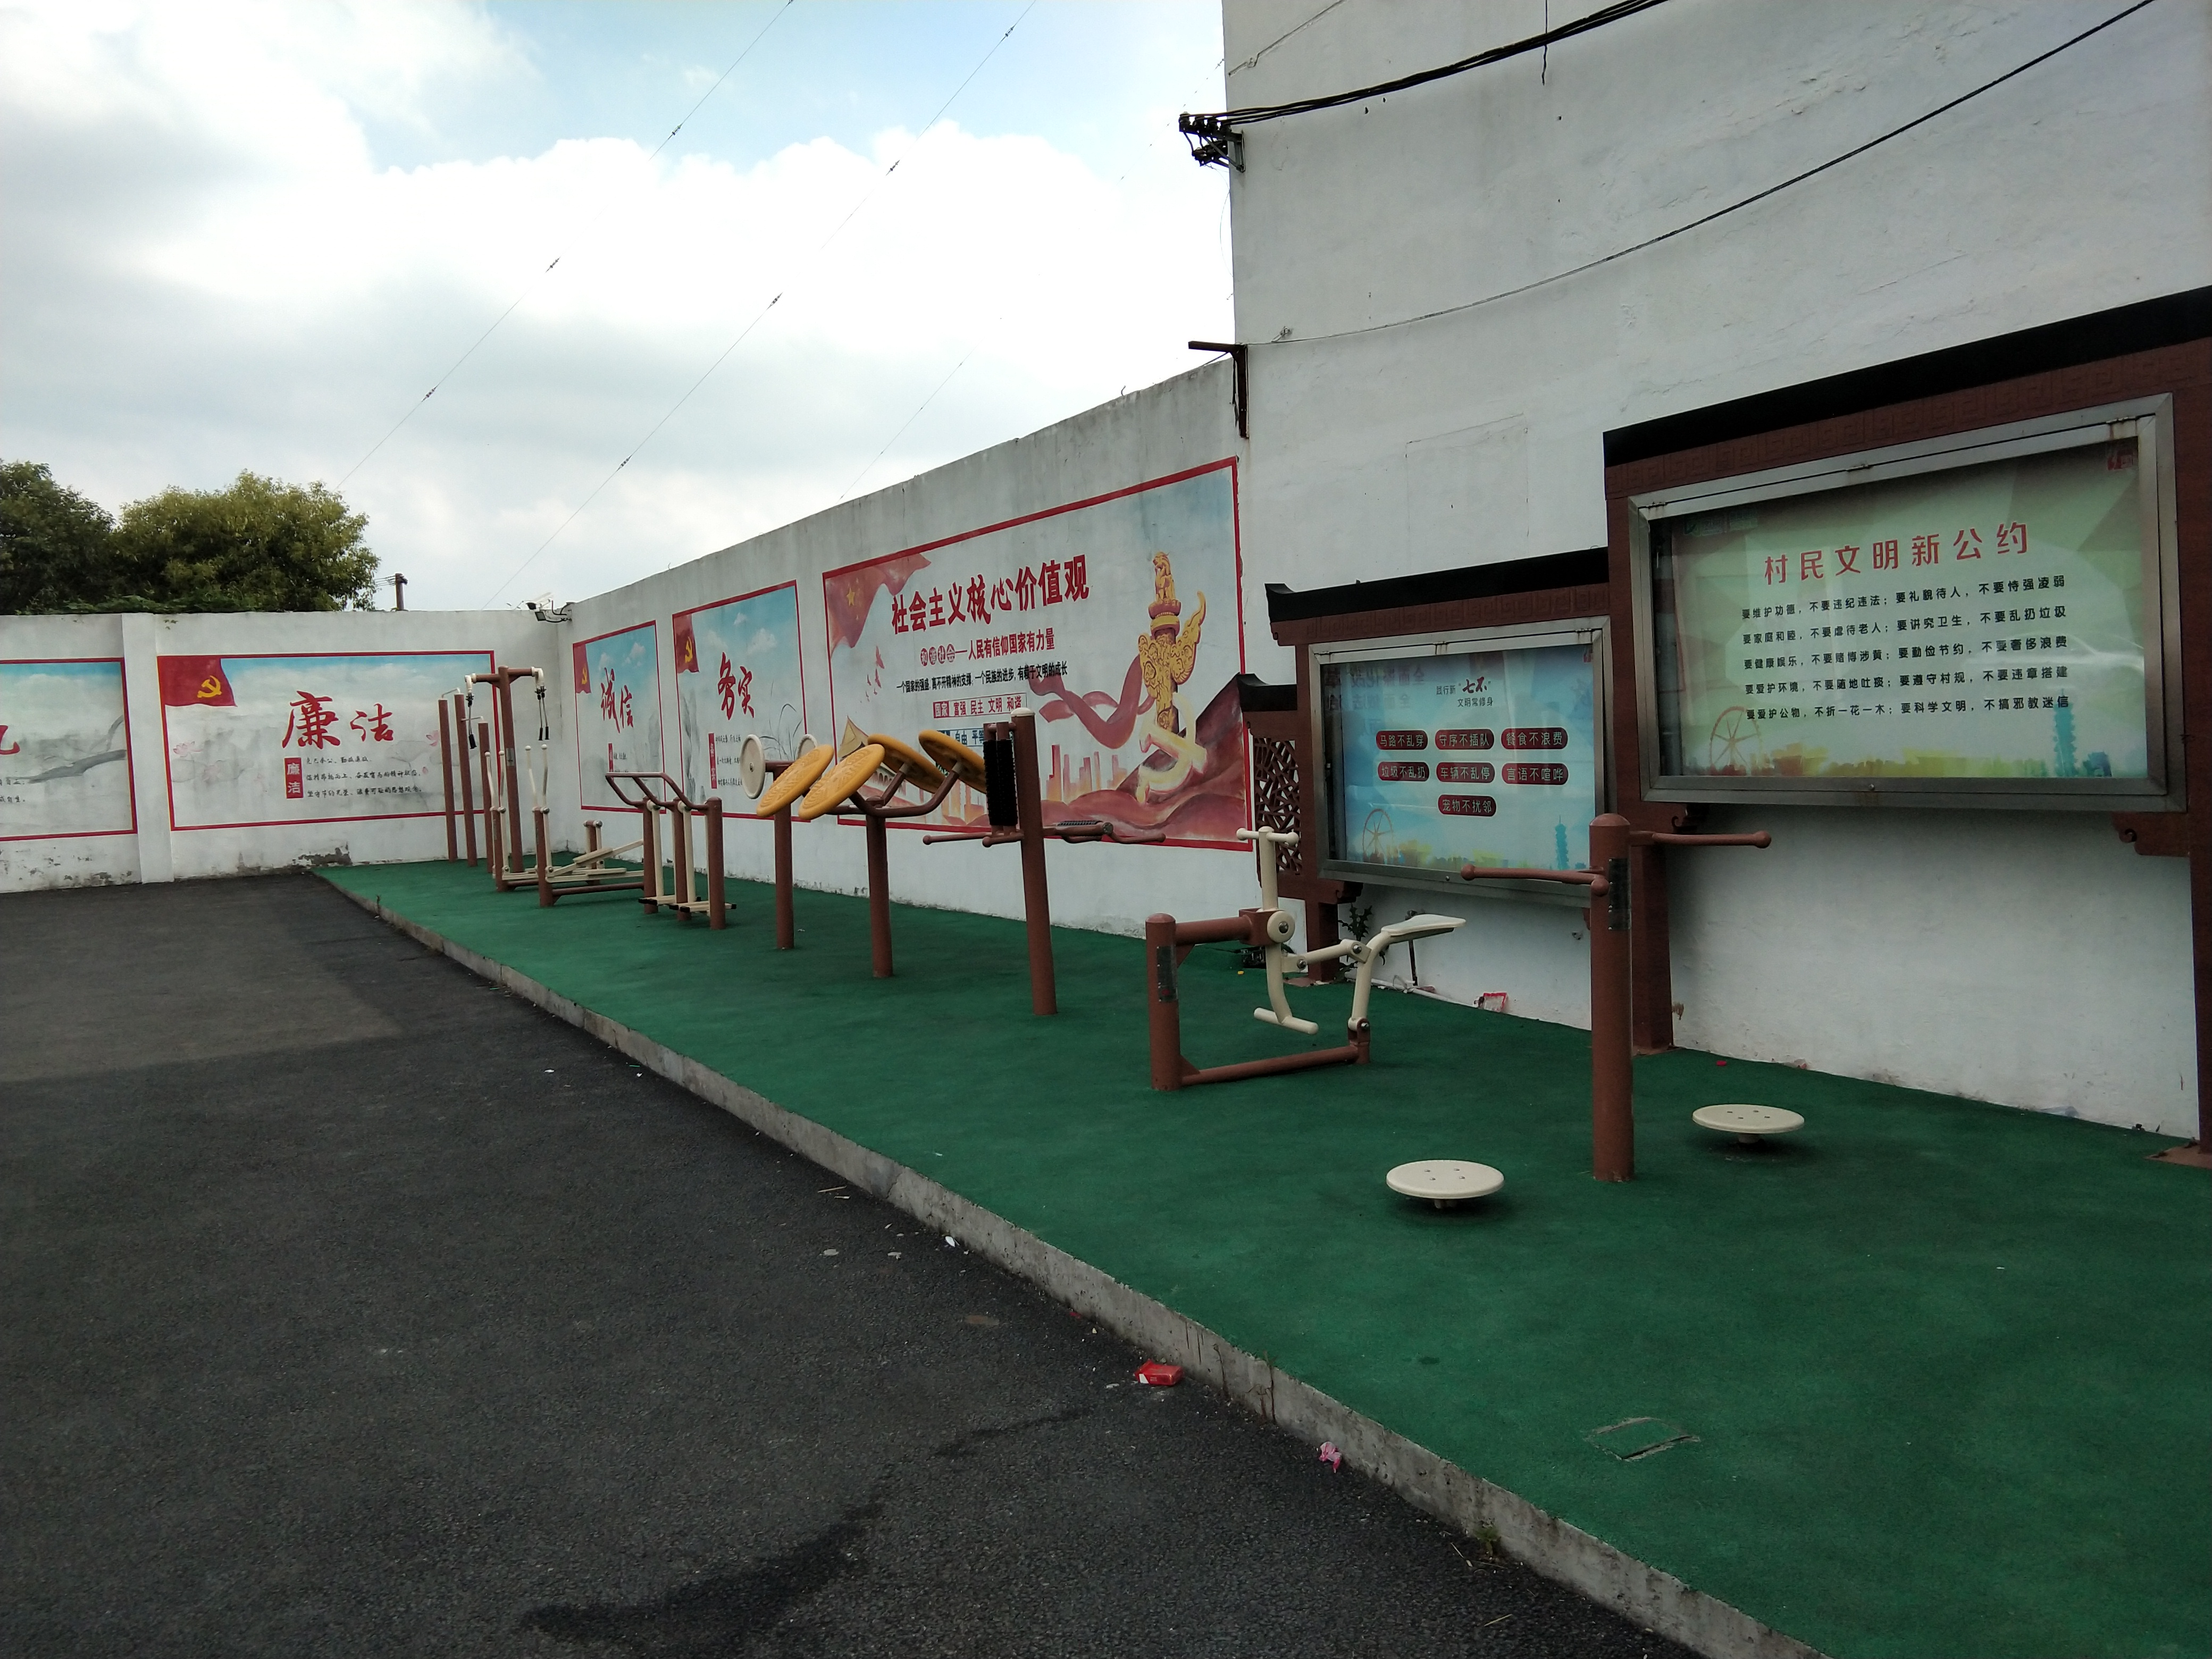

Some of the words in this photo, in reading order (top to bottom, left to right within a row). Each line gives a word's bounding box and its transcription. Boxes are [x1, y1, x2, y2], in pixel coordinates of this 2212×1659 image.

[1764, 522, 2028, 585] 村民文明新公约
[891, 554, 1090, 635] 社会主义核心价值观
[718, 652, 755, 720] 务实
[600, 667, 634, 734] 诚信
[935, 702, 949, 718] 国家
[953, 701, 966, 717] 富强
[970, 700, 984, 715] 民主
[988, 697, 1003, 713] 文明
[1457, 697, 1494, 708] 文明常修身
[282, 690, 395, 750] 廉洁
[1380, 734, 1425, 748] 马路不乱穿
[1438, 733, 1490, 748] 守序不插队
[1505, 731, 1563, 747] 餐食不浪费
[287, 762, 301, 793] 廉洁
[1381, 765, 1426, 779] 垃圾不乱扔
[1440, 766, 1491, 781] 车辆不乱停
[1506, 767, 1564, 782] 言语不喧哗
[1442, 799, 1492, 814] 宠物不扰邻
